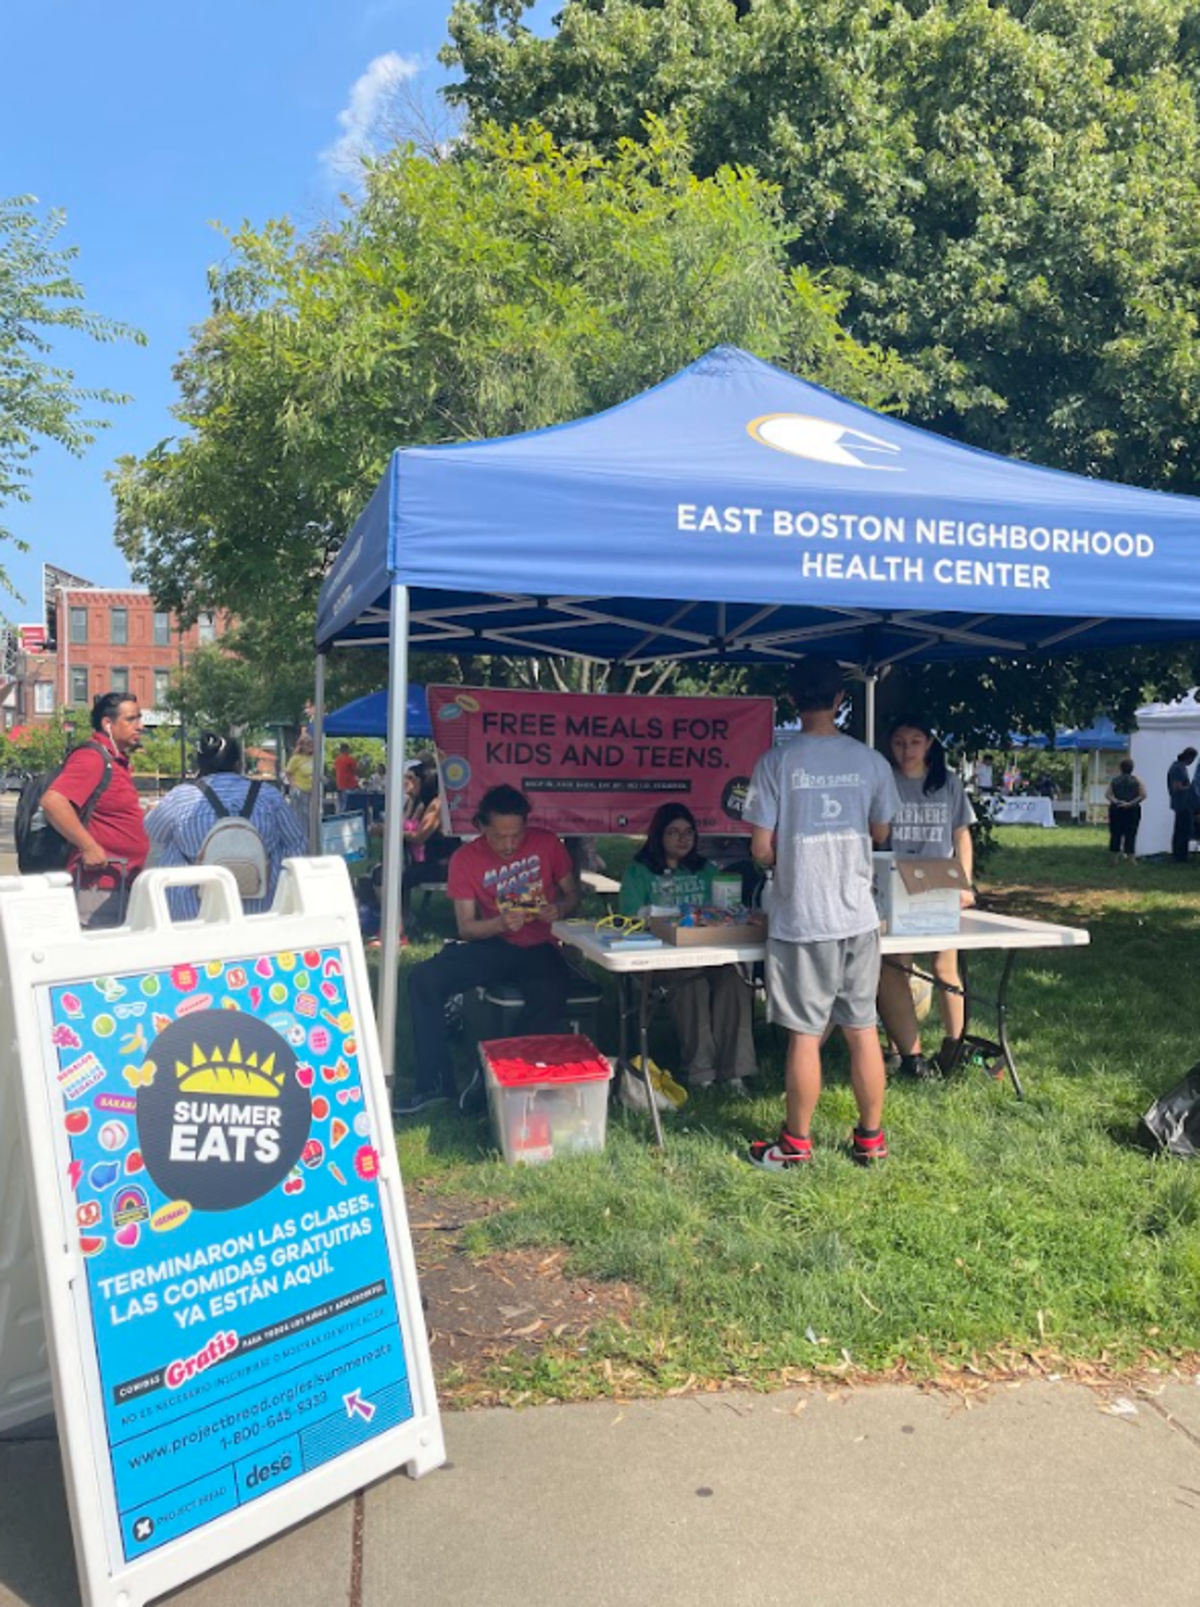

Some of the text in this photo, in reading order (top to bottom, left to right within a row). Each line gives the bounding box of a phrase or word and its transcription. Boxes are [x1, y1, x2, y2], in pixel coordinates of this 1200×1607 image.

[677, 503, 1155, 558] EAST BOSTON NEIGHBORHOOD
[801, 552, 1051, 590] HEALTH CENTER
[482, 712, 730, 741] FREE MEALS FOR
[486, 742, 731, 769] KIDS AND TEENS.
[892, 827, 943, 841] MARKET
[483, 855, 540, 887] MARIO
[497, 866, 540, 895] KART
[173, 1100, 282, 1127] SUMMER
[169, 1124, 281, 1164] EATS
[98, 1194, 375, 1299] TERMINARON LAS CLASES.
[110, 1217, 373, 1326] LAS COMIDAS GRATUITAS
[173, 1254, 334, 1329] YA ESTÁN AQUÍ.
[119, 1374, 161, 1397] COMIDAS
[166, 1330, 238, 1388] Gratis
[128, 1343, 393, 1471] www.projectbread.org/es/summereats
[245, 1453, 292, 1489] dese
